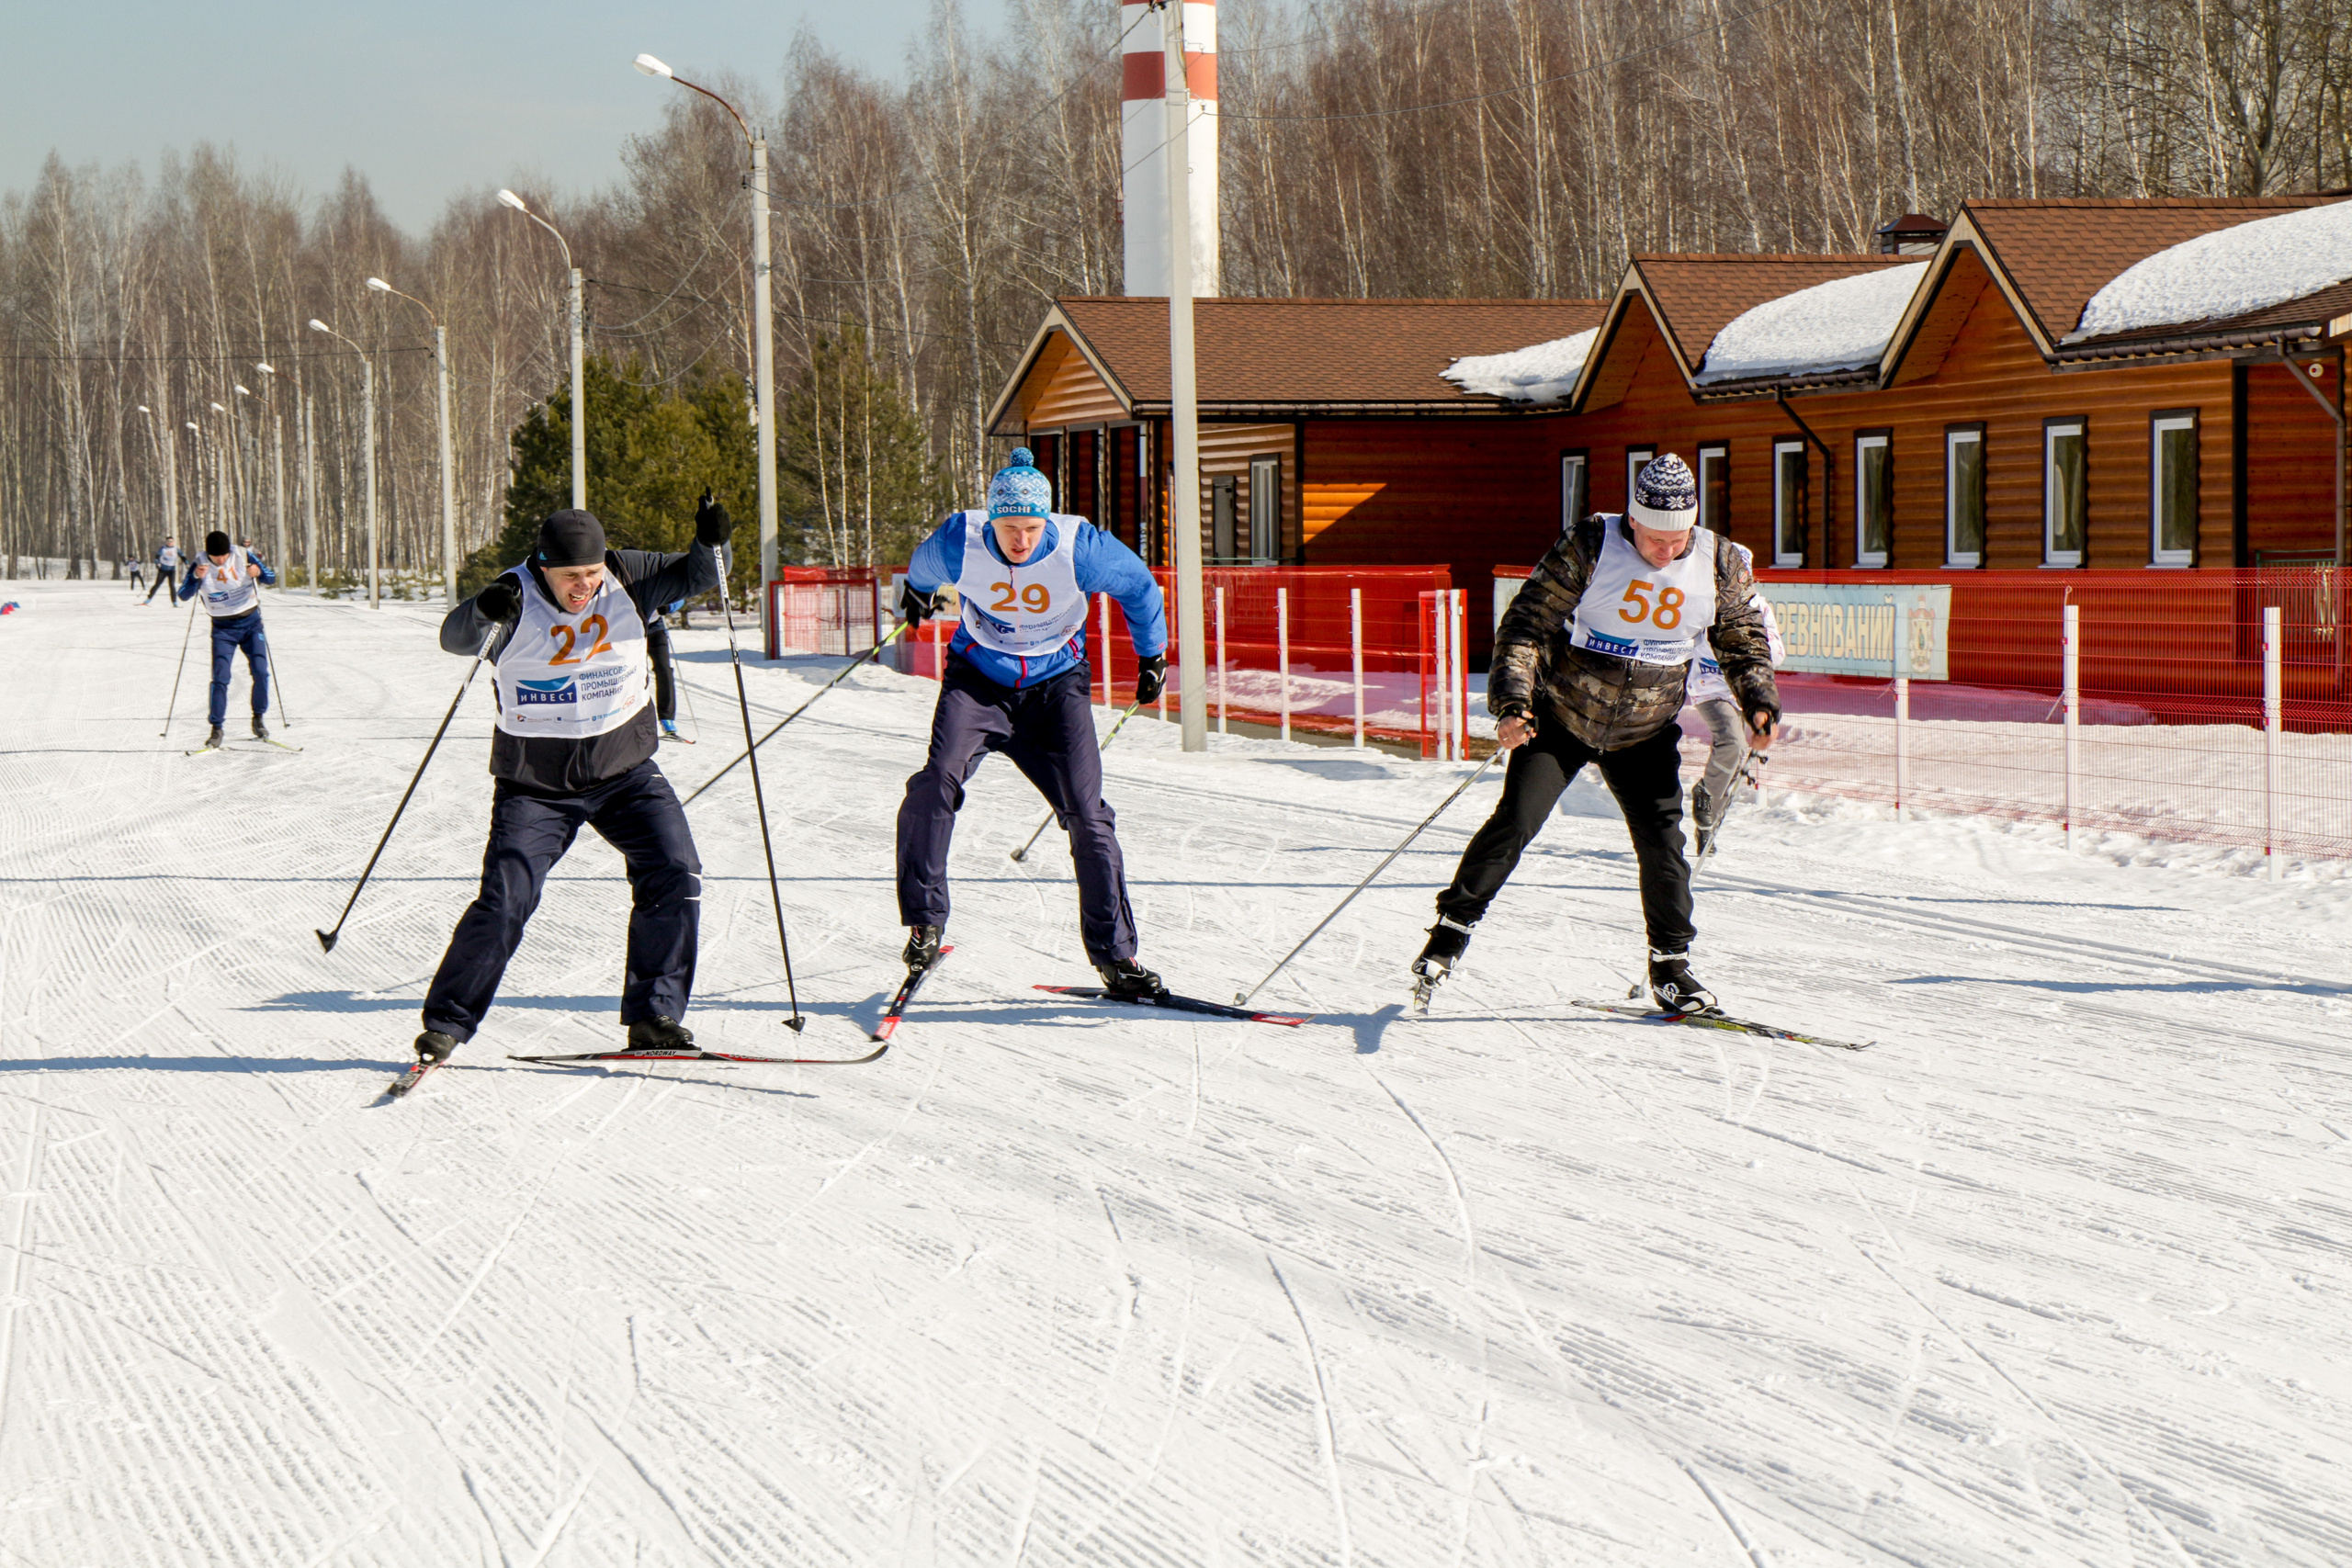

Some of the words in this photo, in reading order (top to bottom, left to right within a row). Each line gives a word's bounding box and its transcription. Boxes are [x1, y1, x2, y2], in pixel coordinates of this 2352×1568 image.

[997, 505, 1031, 513] SOCHI
[989, 581, 1051, 614] 29
[1618, 579, 1686, 630] 58
[548, 614, 613, 666] 22
[1589, 638, 1634, 655] ИНВЕСТ
[520, 692, 574, 703] ИНВЕСТ
